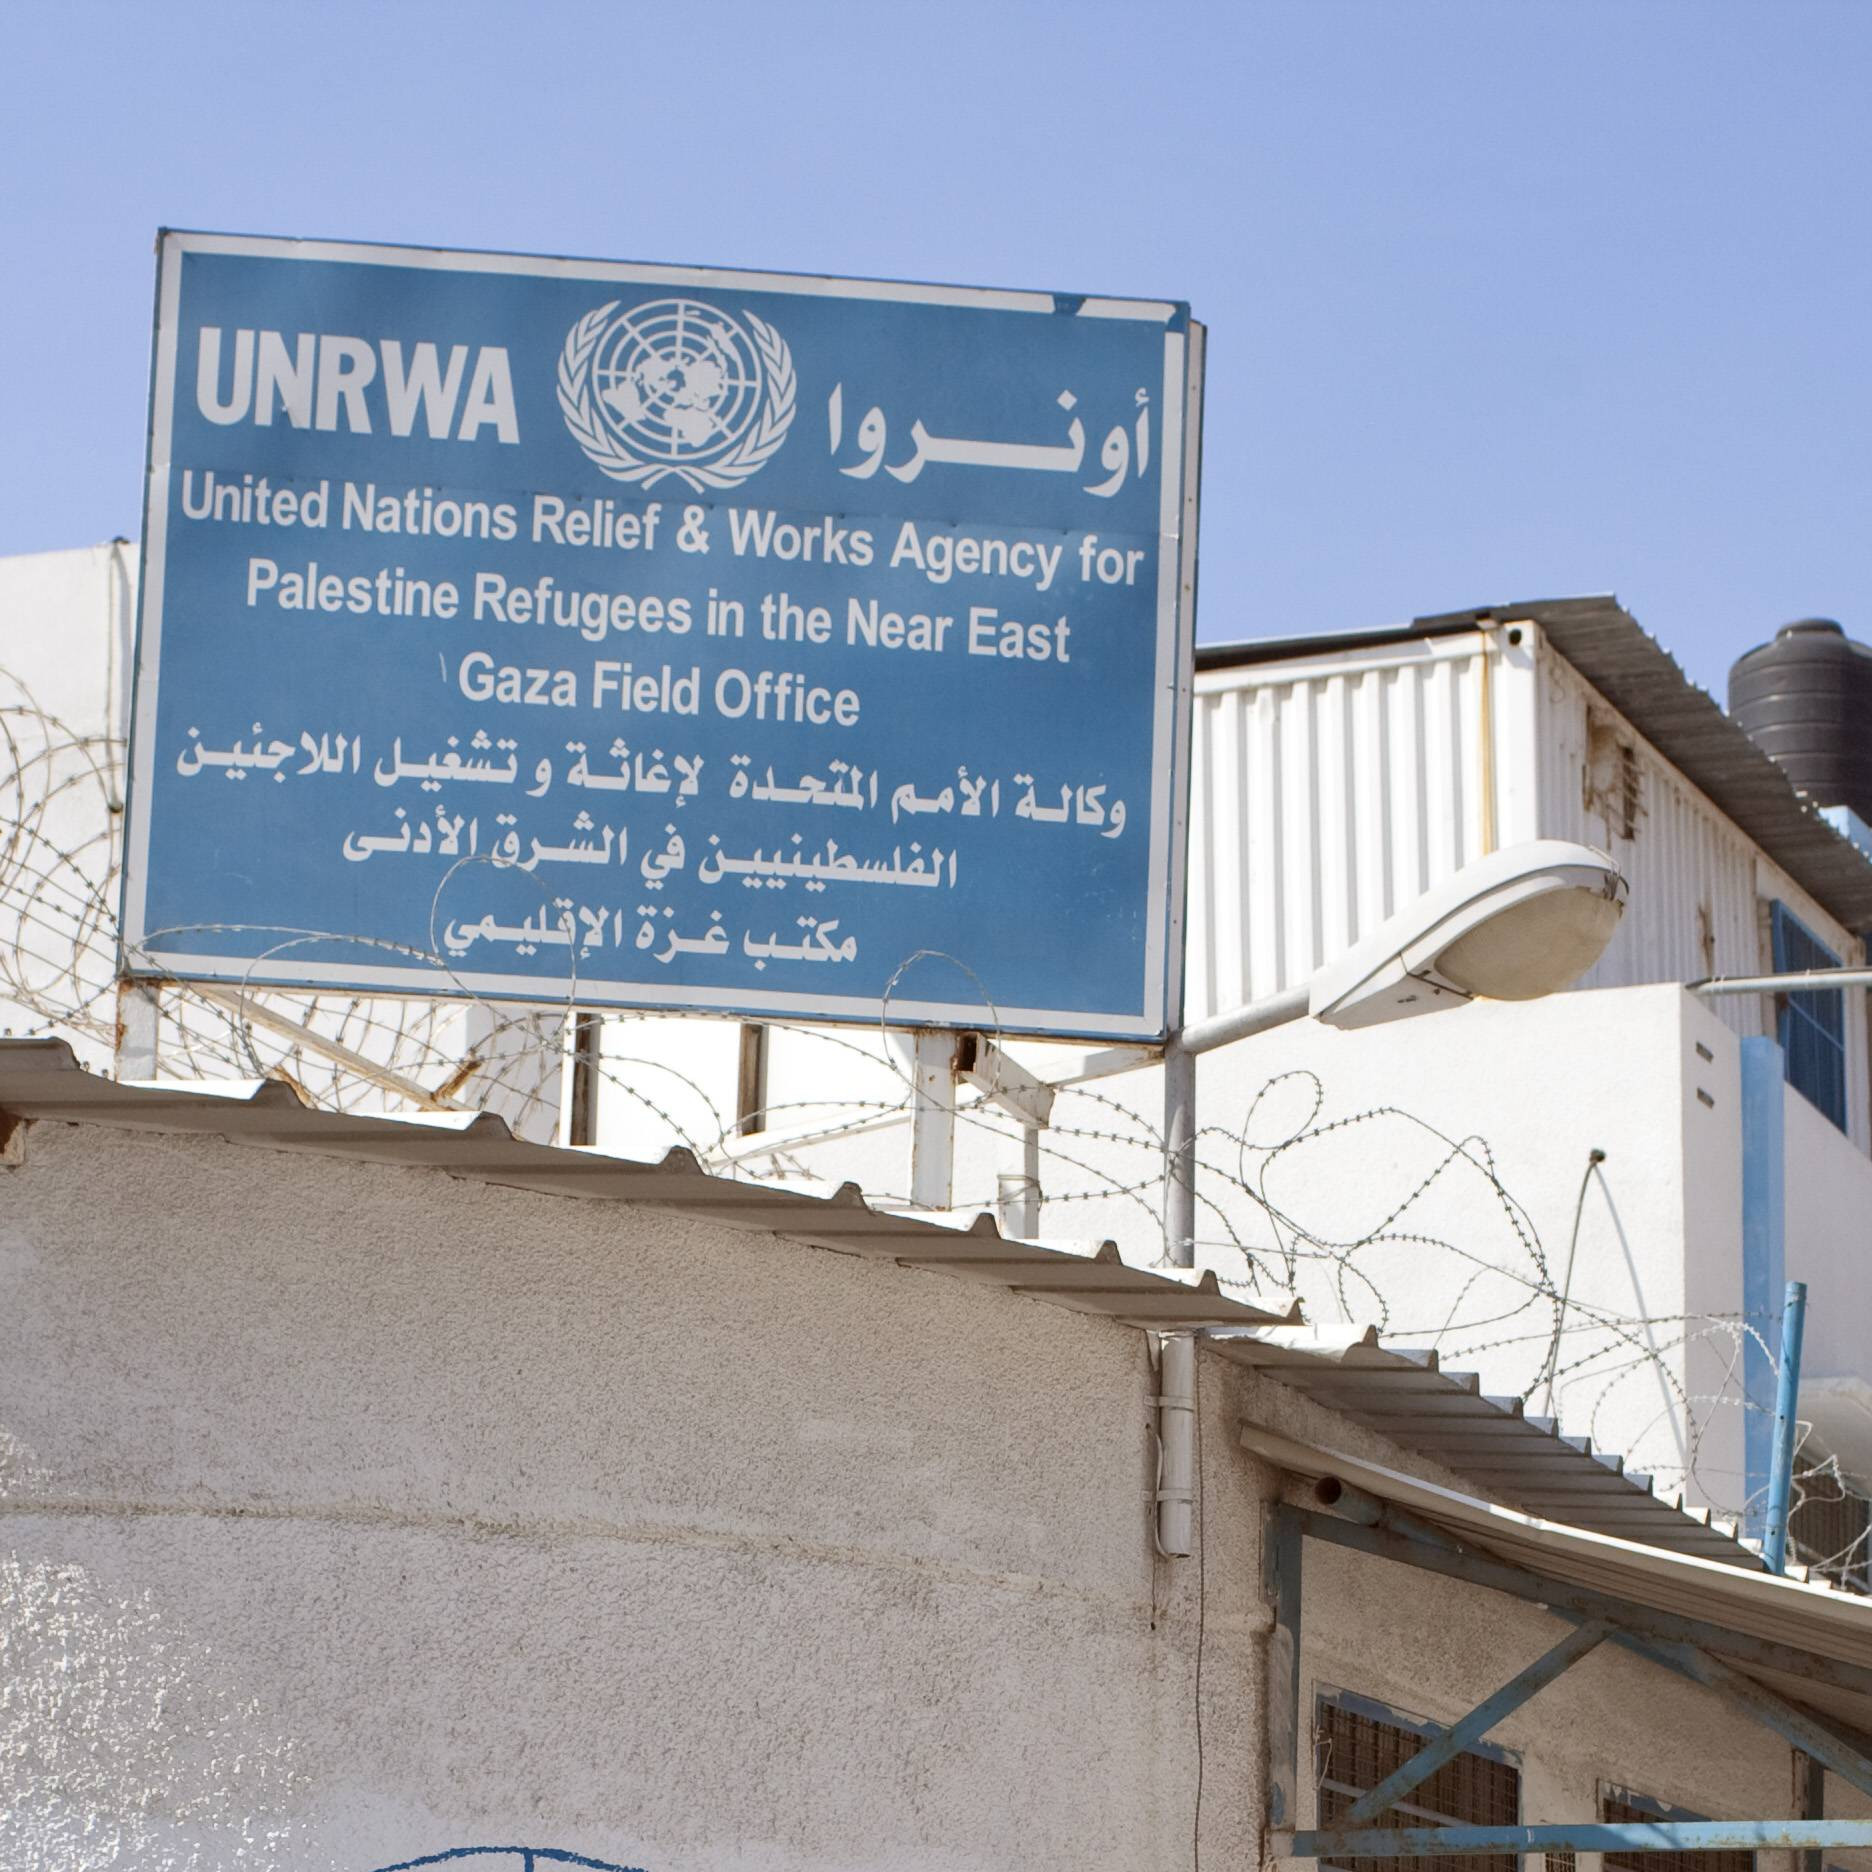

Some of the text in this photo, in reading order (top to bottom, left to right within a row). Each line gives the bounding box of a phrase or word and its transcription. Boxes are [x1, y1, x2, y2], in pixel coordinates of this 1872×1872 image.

[197, 326, 520, 444] UNRWA
[828, 384, 1149, 498] أونروا
[183, 469, 1145, 590] United Nations Relief & Works Agency for
[248, 559, 1071, 663] Palestine Refugees in the Near East
[459, 652, 860, 726] Gaza Field Office
[177, 722, 1126, 839] وكالة الأمم المتحدة لإغاثة و تشغيل اللاجئين
[342, 804, 957, 893] الفلسطينيين في الشرق الأدنى
[443, 898, 858, 971] مكتب غزة الإقليمي
